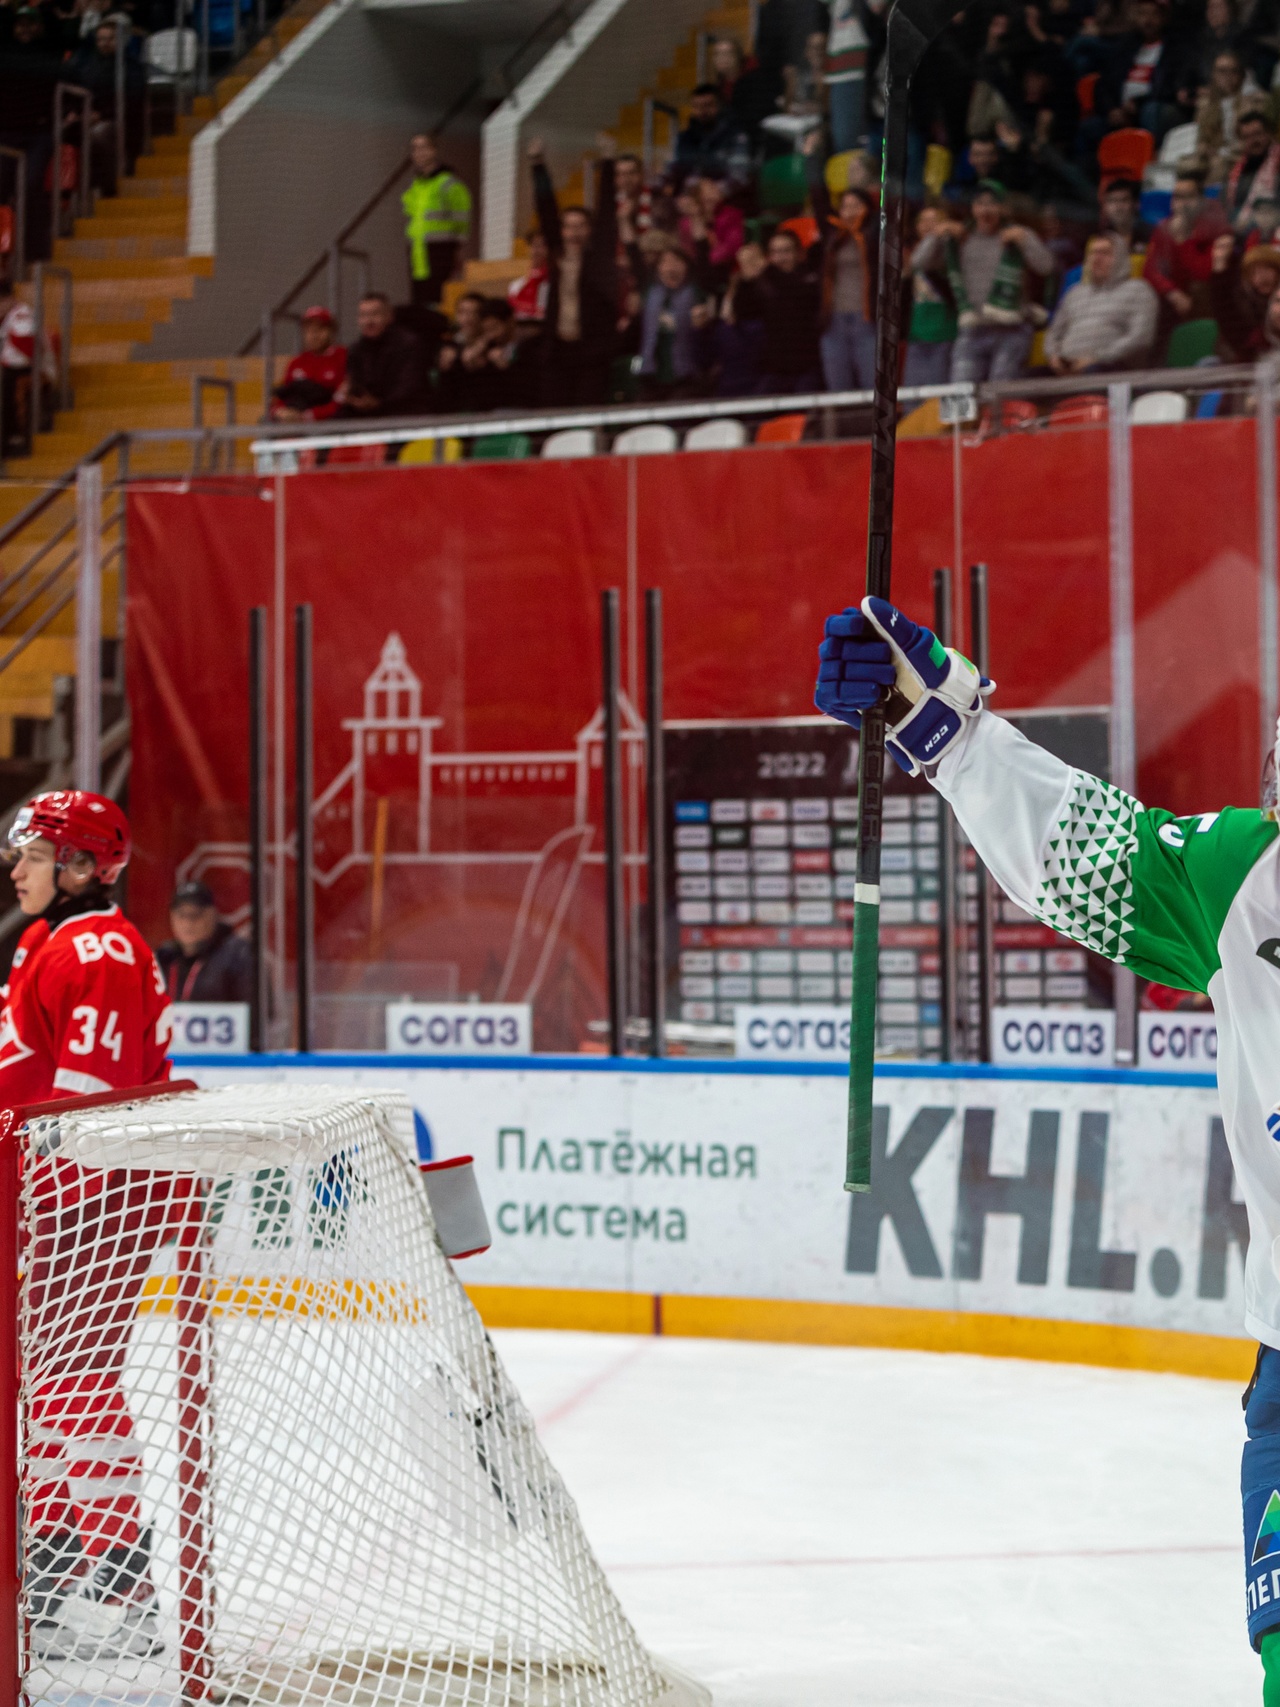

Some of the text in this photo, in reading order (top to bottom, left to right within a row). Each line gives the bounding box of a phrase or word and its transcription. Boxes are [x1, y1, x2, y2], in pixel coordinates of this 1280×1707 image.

[924, 724, 949, 753] CCM
[757, 752, 827, 779] 2022
[68, 1004, 123, 1062] 34
[401, 1016, 519, 1046] согаз
[1003, 1020, 1106, 1056] согаз
[497, 1126, 758, 1179] Платёжная
[844, 1103, 1250, 1300] KHL.R
[496, 1201, 687, 1242] система
